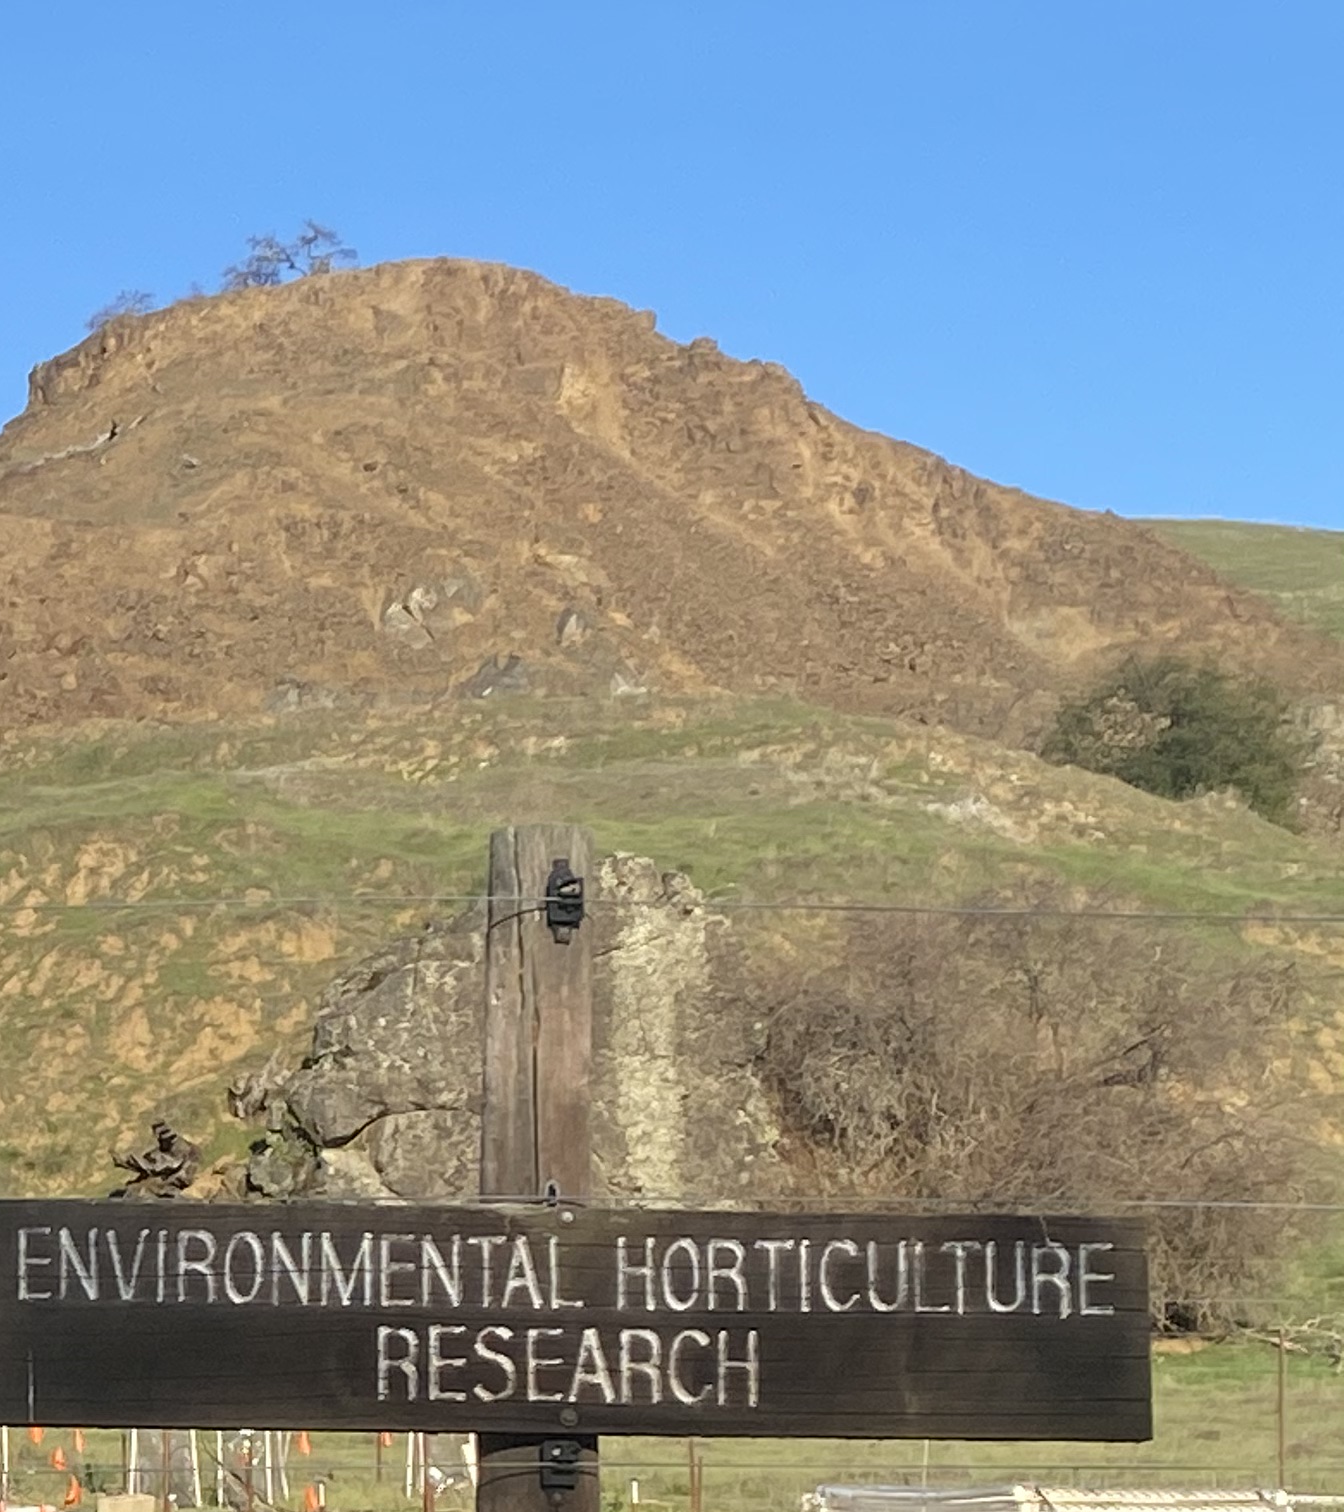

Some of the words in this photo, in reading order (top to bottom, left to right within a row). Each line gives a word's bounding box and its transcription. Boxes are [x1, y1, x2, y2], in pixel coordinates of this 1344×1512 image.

[16, 1226, 586, 1311] ENVIRONMENTAL
[615, 1236, 1116, 1319] HORTICULTURE
[376, 1325, 761, 1407] RESEARCH
